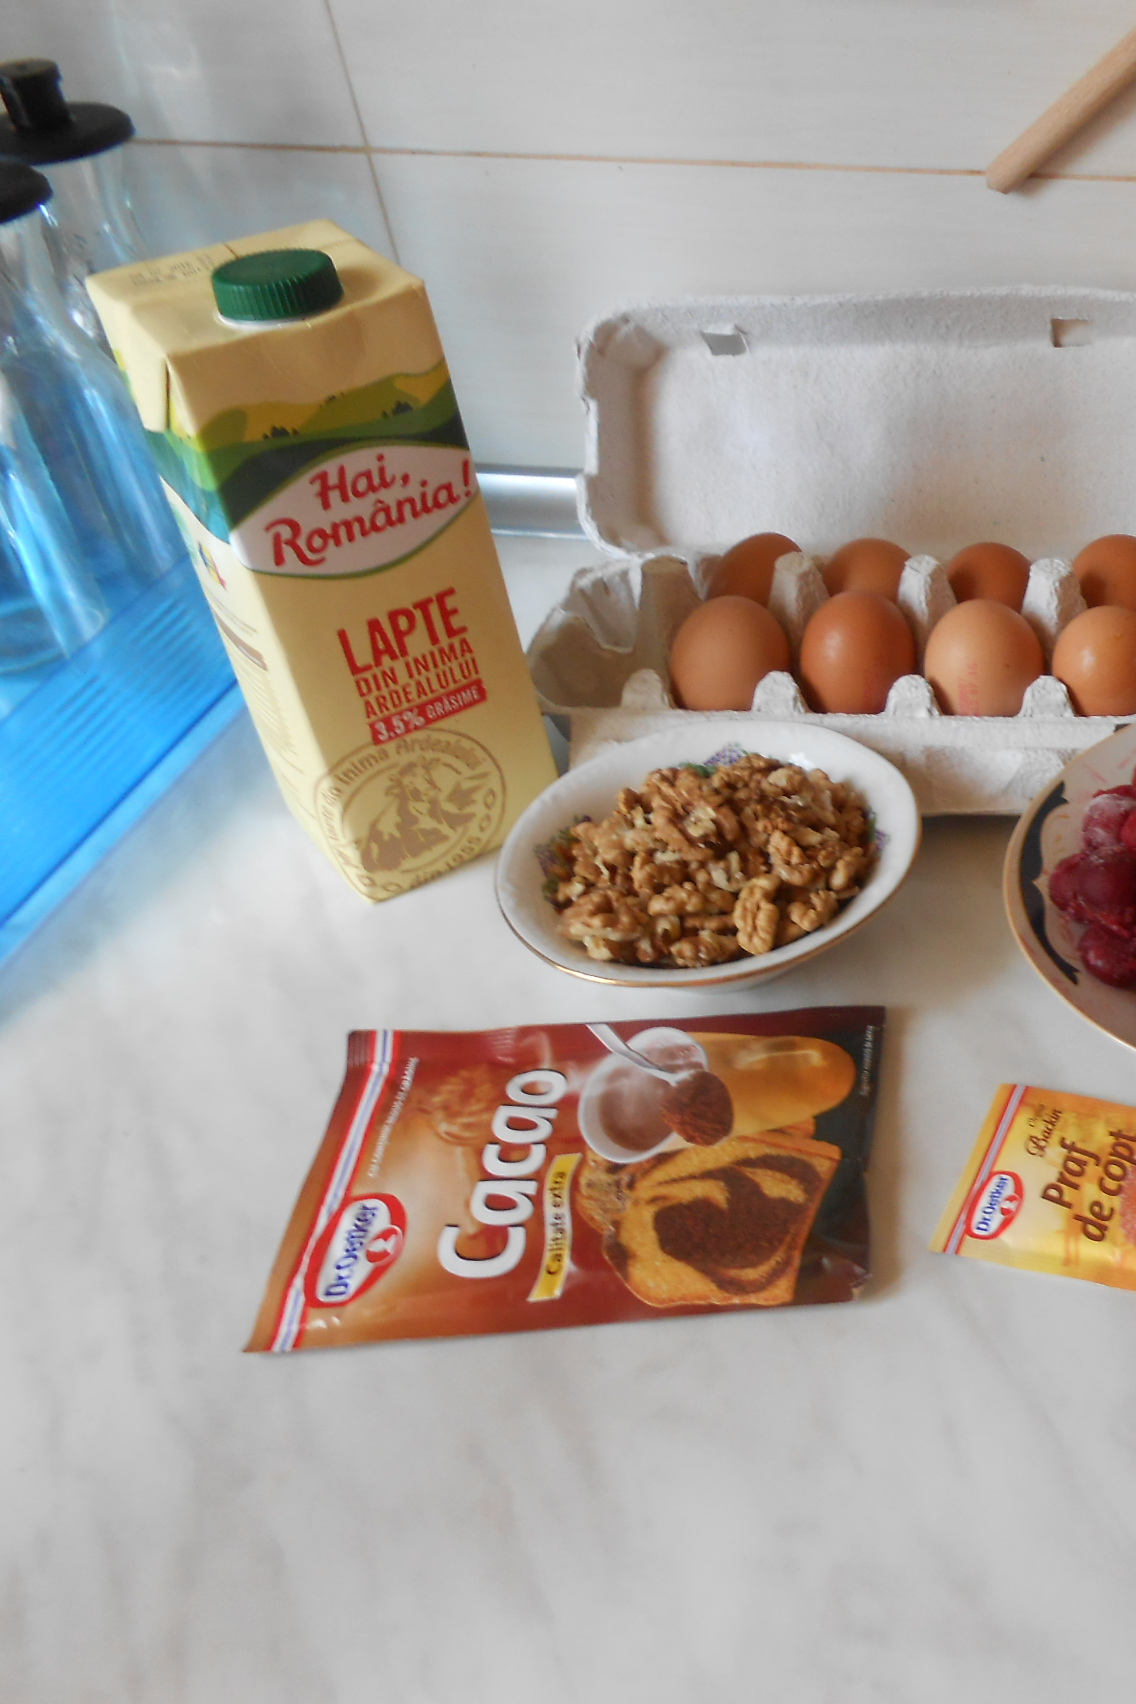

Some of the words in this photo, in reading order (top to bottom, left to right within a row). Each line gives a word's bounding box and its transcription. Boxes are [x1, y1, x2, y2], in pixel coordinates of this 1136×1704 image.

[264, 458, 472, 567] România!
[309, 453, 410, 511] Hai,
[337, 587, 468, 676] LAPTE
[355, 666, 399, 698] DIN
[404, 637, 474, 679] INIMA
[364, 656, 481, 719] ARDEALULUI
[374, 708, 426, 741] 3.5%
[1025, 1109, 1062, 1157] Backin
[436, 1067, 569, 1279] Cacao
[548, 1170, 567, 1210] extra
[1041, 1137, 1101, 1209] Praf
[545, 1213, 567, 1276] Calitate
[1073, 1200, 1114, 1242] de
